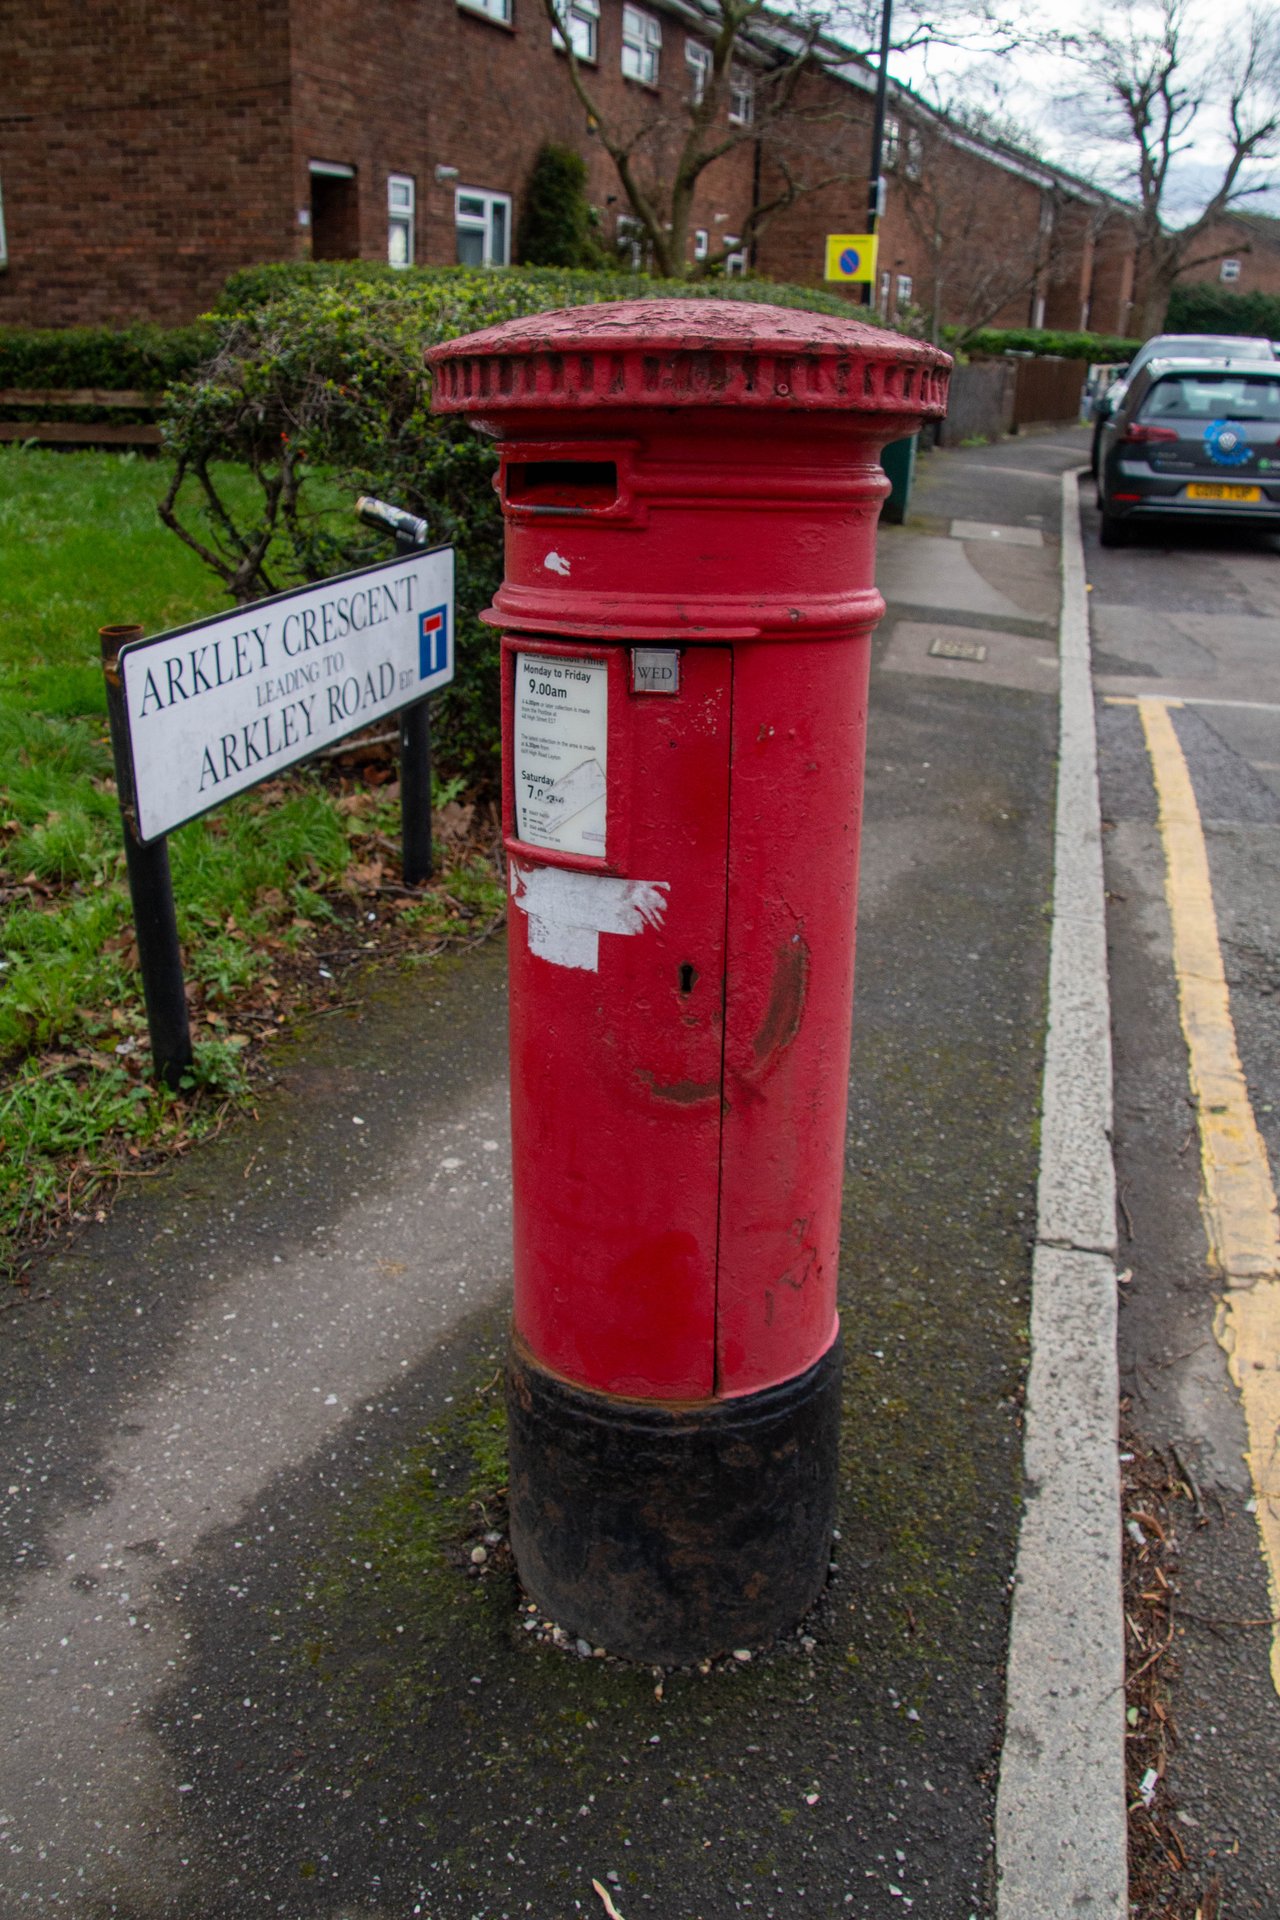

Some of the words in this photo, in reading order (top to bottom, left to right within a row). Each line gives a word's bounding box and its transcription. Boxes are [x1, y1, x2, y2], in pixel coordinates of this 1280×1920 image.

[139, 623, 272, 718] ARKLEY
[282, 574, 418, 657] CRESCENT
[256, 662, 320, 707] LEADING
[325, 652, 345, 677] TO
[523, 663, 552, 679] Monday
[554, 669, 562, 678] to
[565, 669, 591, 683] Friday
[637, 666, 673, 680] WED
[529, 679, 567, 698] 9.00am
[198, 694, 316, 793] ARKLEY
[327, 661, 396, 726] ROAD
[521, 770, 555, 787] Saturday
